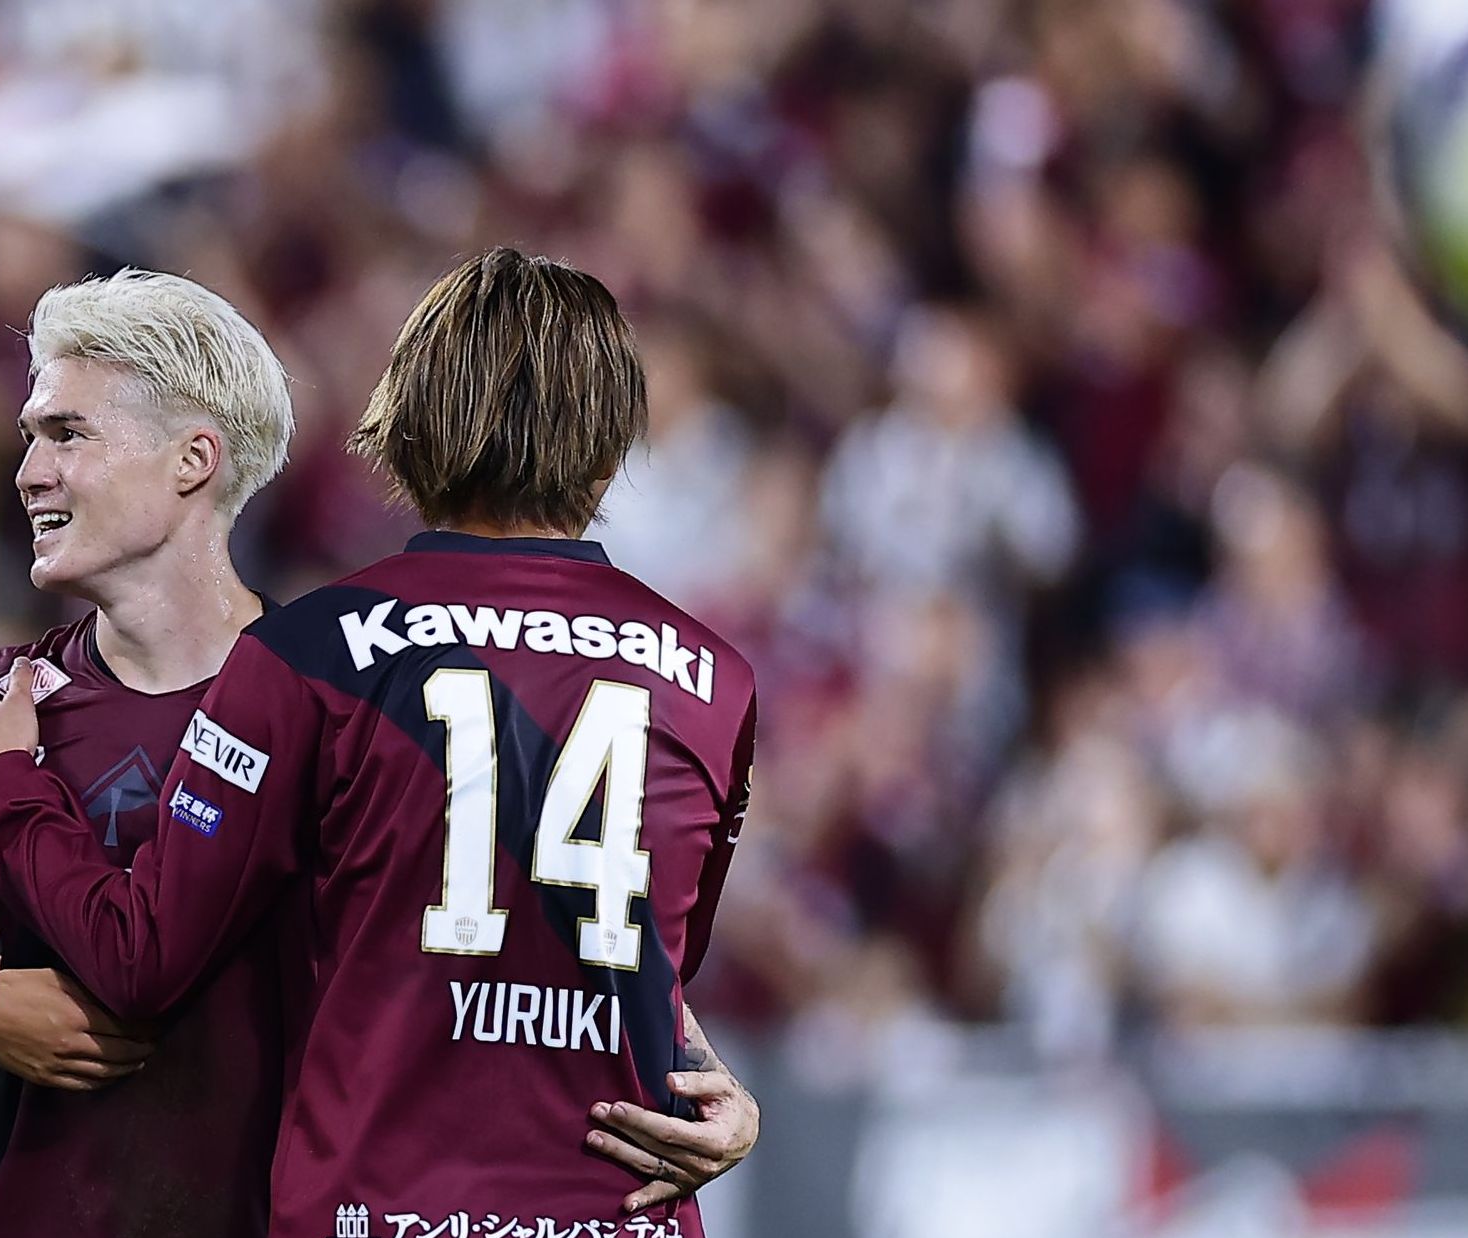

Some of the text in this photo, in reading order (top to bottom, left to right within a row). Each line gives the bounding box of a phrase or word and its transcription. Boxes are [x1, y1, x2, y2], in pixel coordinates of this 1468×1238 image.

[339, 599, 715, 705] Kawasaki
[421, 668, 651, 972] 14
[450, 981, 621, 1055] YURUKI
